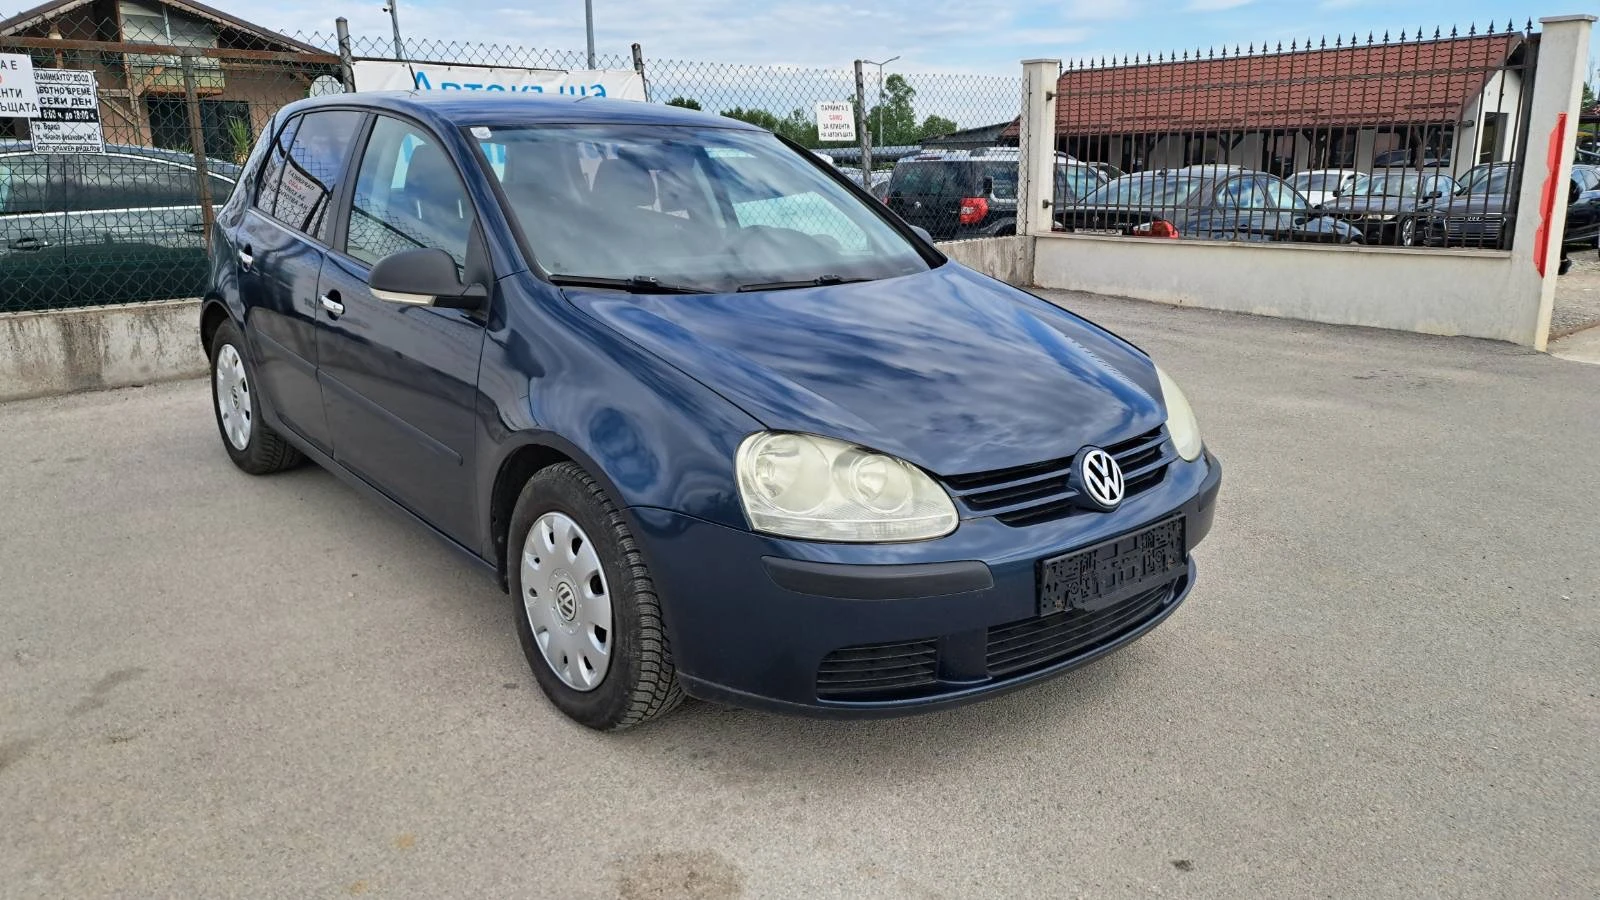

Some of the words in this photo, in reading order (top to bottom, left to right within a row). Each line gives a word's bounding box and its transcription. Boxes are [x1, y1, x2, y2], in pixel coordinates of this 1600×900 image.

[11, 60, 17, 70] Е
[0, 88, 22, 98] НТИ
[66, 87, 92, 96] ВРЕМЕ
[72, 98, 92, 106] ДЕН
